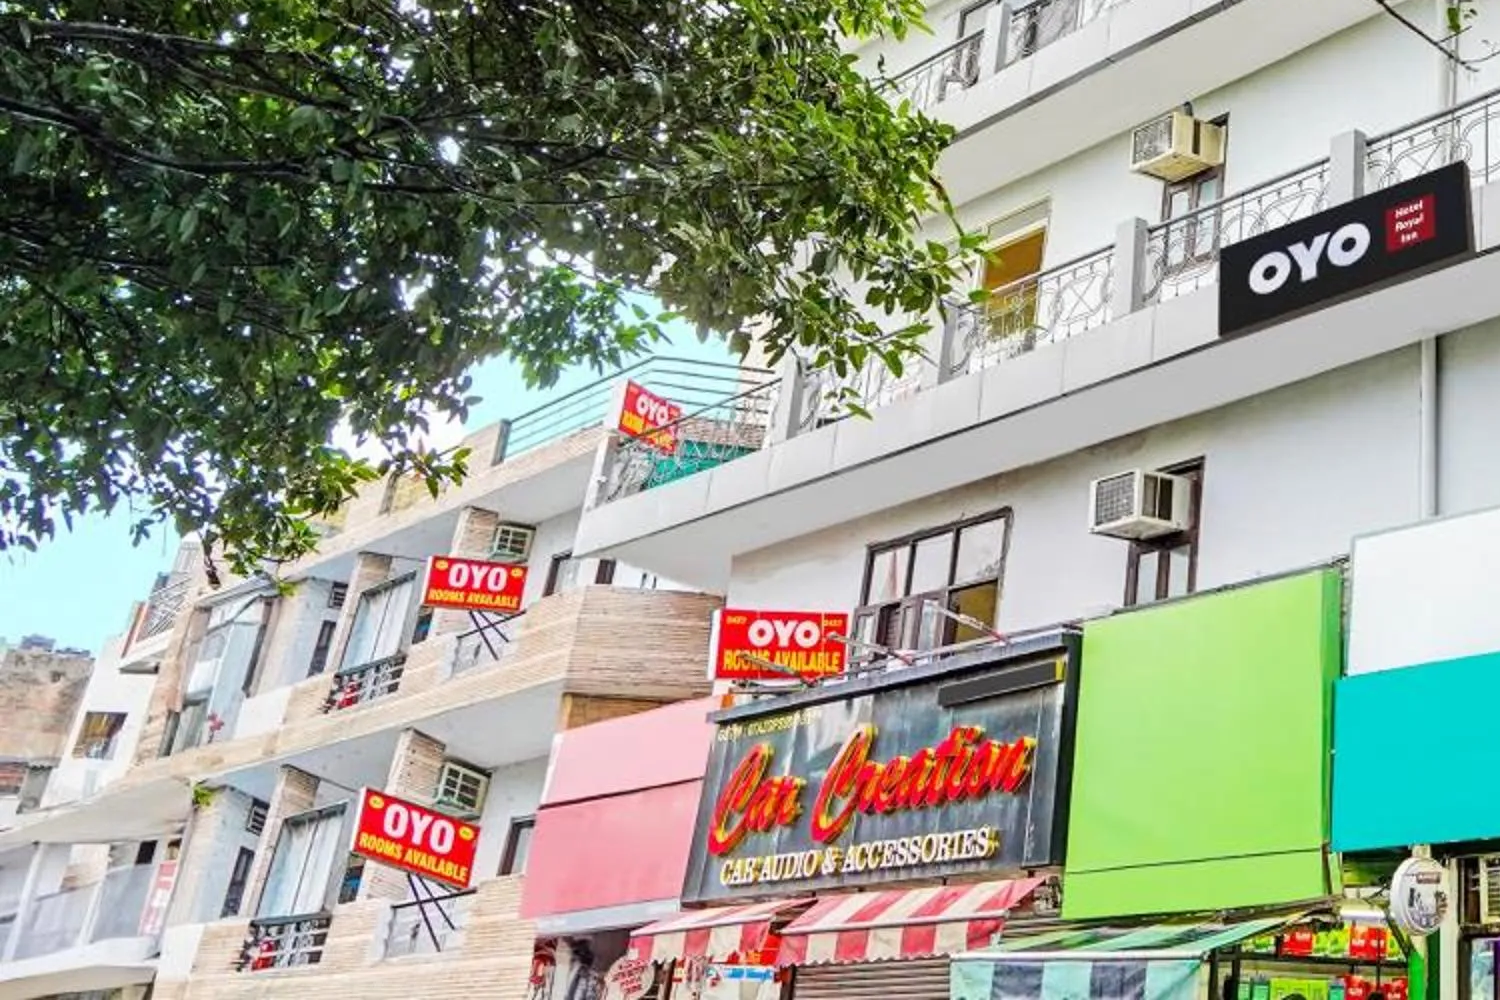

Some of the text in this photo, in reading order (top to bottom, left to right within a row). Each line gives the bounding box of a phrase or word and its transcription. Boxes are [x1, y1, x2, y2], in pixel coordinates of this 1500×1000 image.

[1395, 200, 1423, 219] Hotel
[1248, 222, 1371, 295] OYO
[636, 393, 669, 426] OYO
[448, 563, 508, 592] OYO
[428, 588, 519, 608] ROOMS AVAILABLE
[748, 619, 820, 648] OYO
[773, 650, 841, 673] AVAILABLE
[707, 722, 1037, 857] Car Creation
[383, 803, 455, 855] OYO
[359, 832, 469, 883] ROOMS AVAILABLE
[719, 823, 1000, 887] CAR AUDIO & ACCESSORIES
